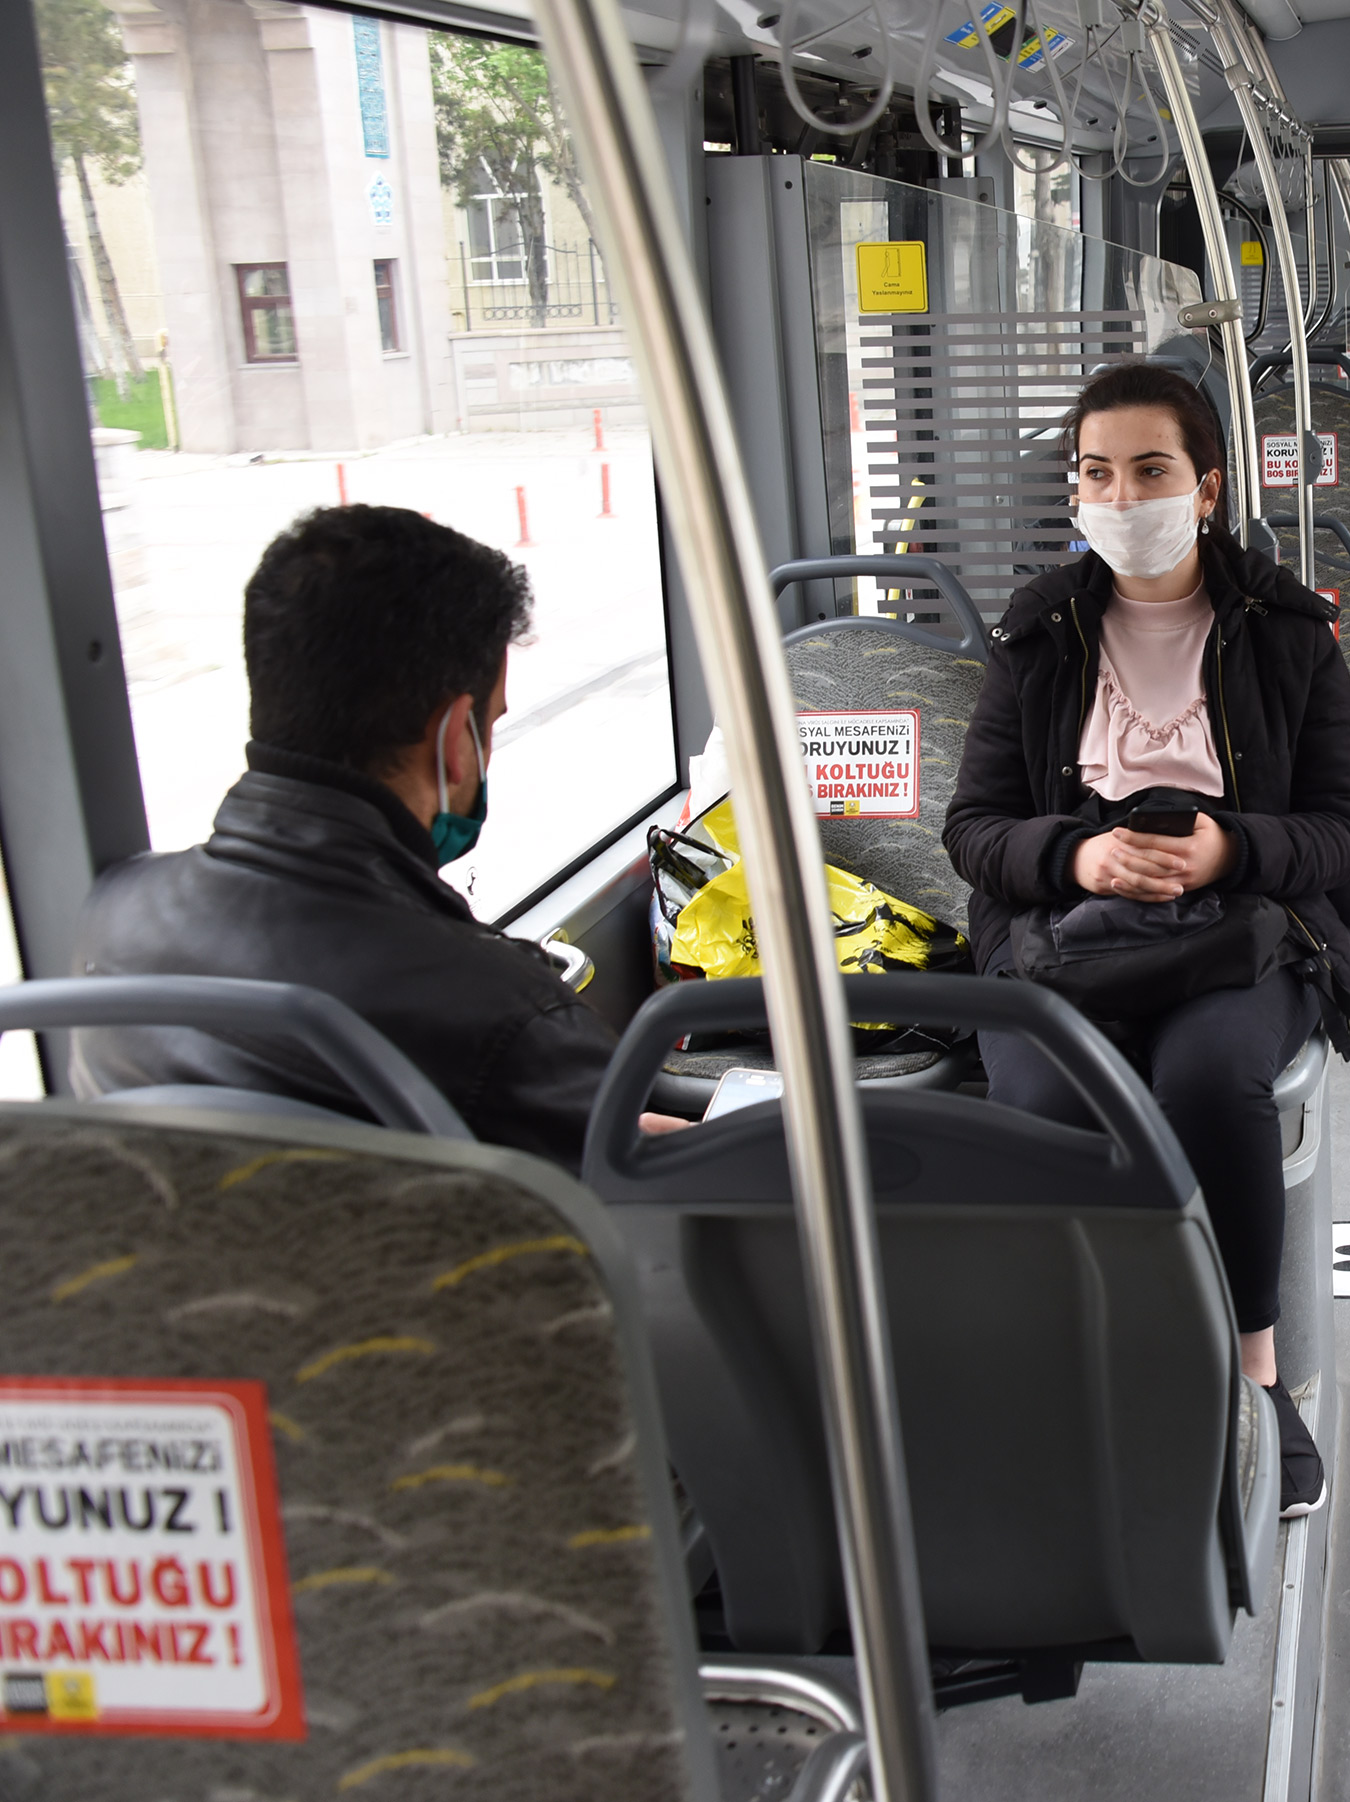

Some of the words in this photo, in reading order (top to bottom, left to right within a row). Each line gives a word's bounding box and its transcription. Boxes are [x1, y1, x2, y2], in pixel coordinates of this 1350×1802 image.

[1267, 460, 1281, 469] BU
[800, 726, 831, 738] SYAL
[800, 740, 899, 756] ORUYUNUZ
[816, 761, 910, 780] KOLTUĞU
[817, 782, 899, 799] BIRAKINIZ
[0, 1619, 216, 1667] RAKINIZ
